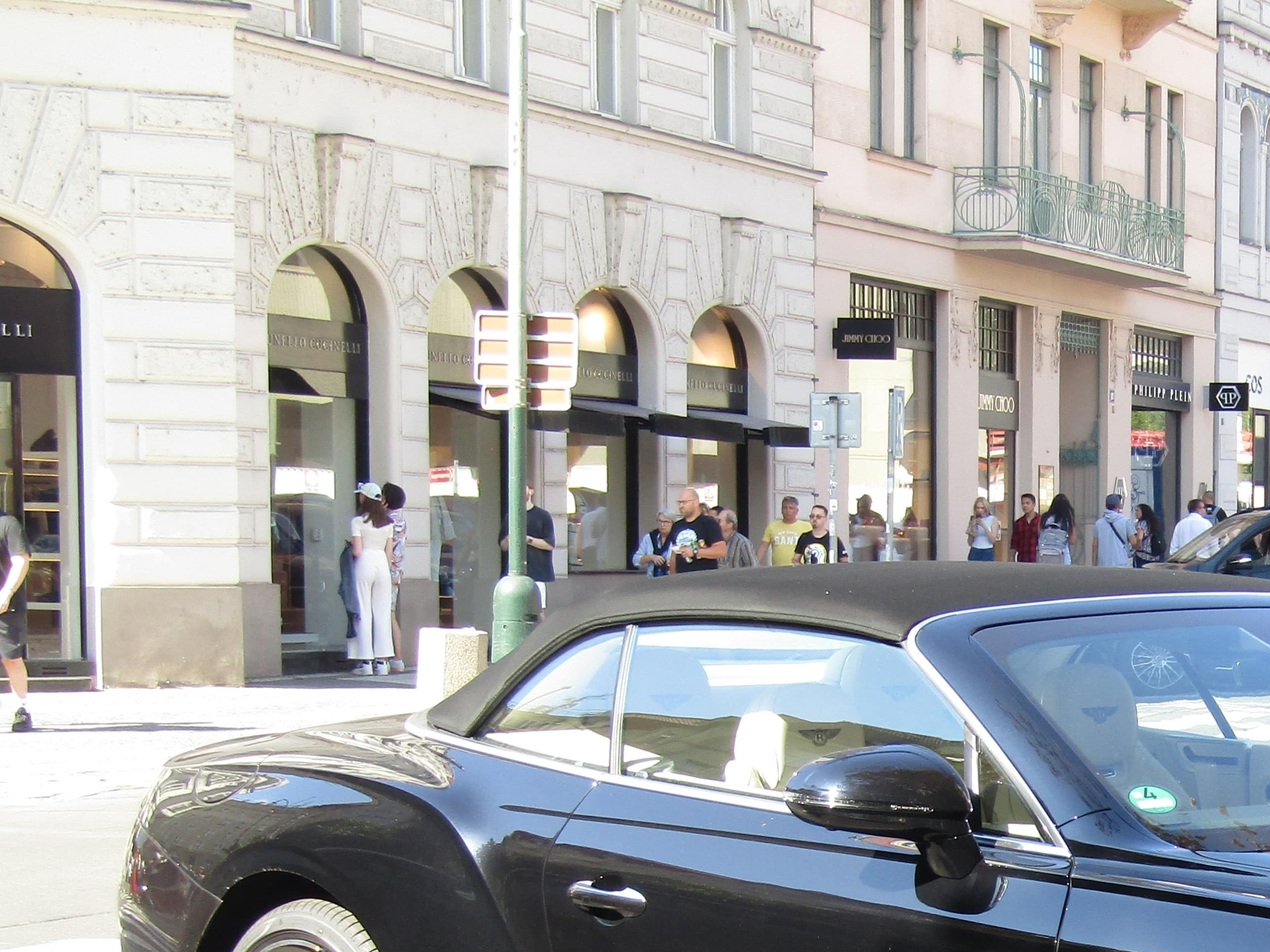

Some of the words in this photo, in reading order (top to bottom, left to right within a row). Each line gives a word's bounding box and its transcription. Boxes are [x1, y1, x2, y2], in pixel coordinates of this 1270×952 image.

[842, 334, 864, 343] JIMMY
[864, 334, 891, 344] CHOO
[1134, 384, 1166, 399] PHILIPP
[1170, 388, 1192, 403] PLEIN
[1143, 786, 1158, 800] 4
